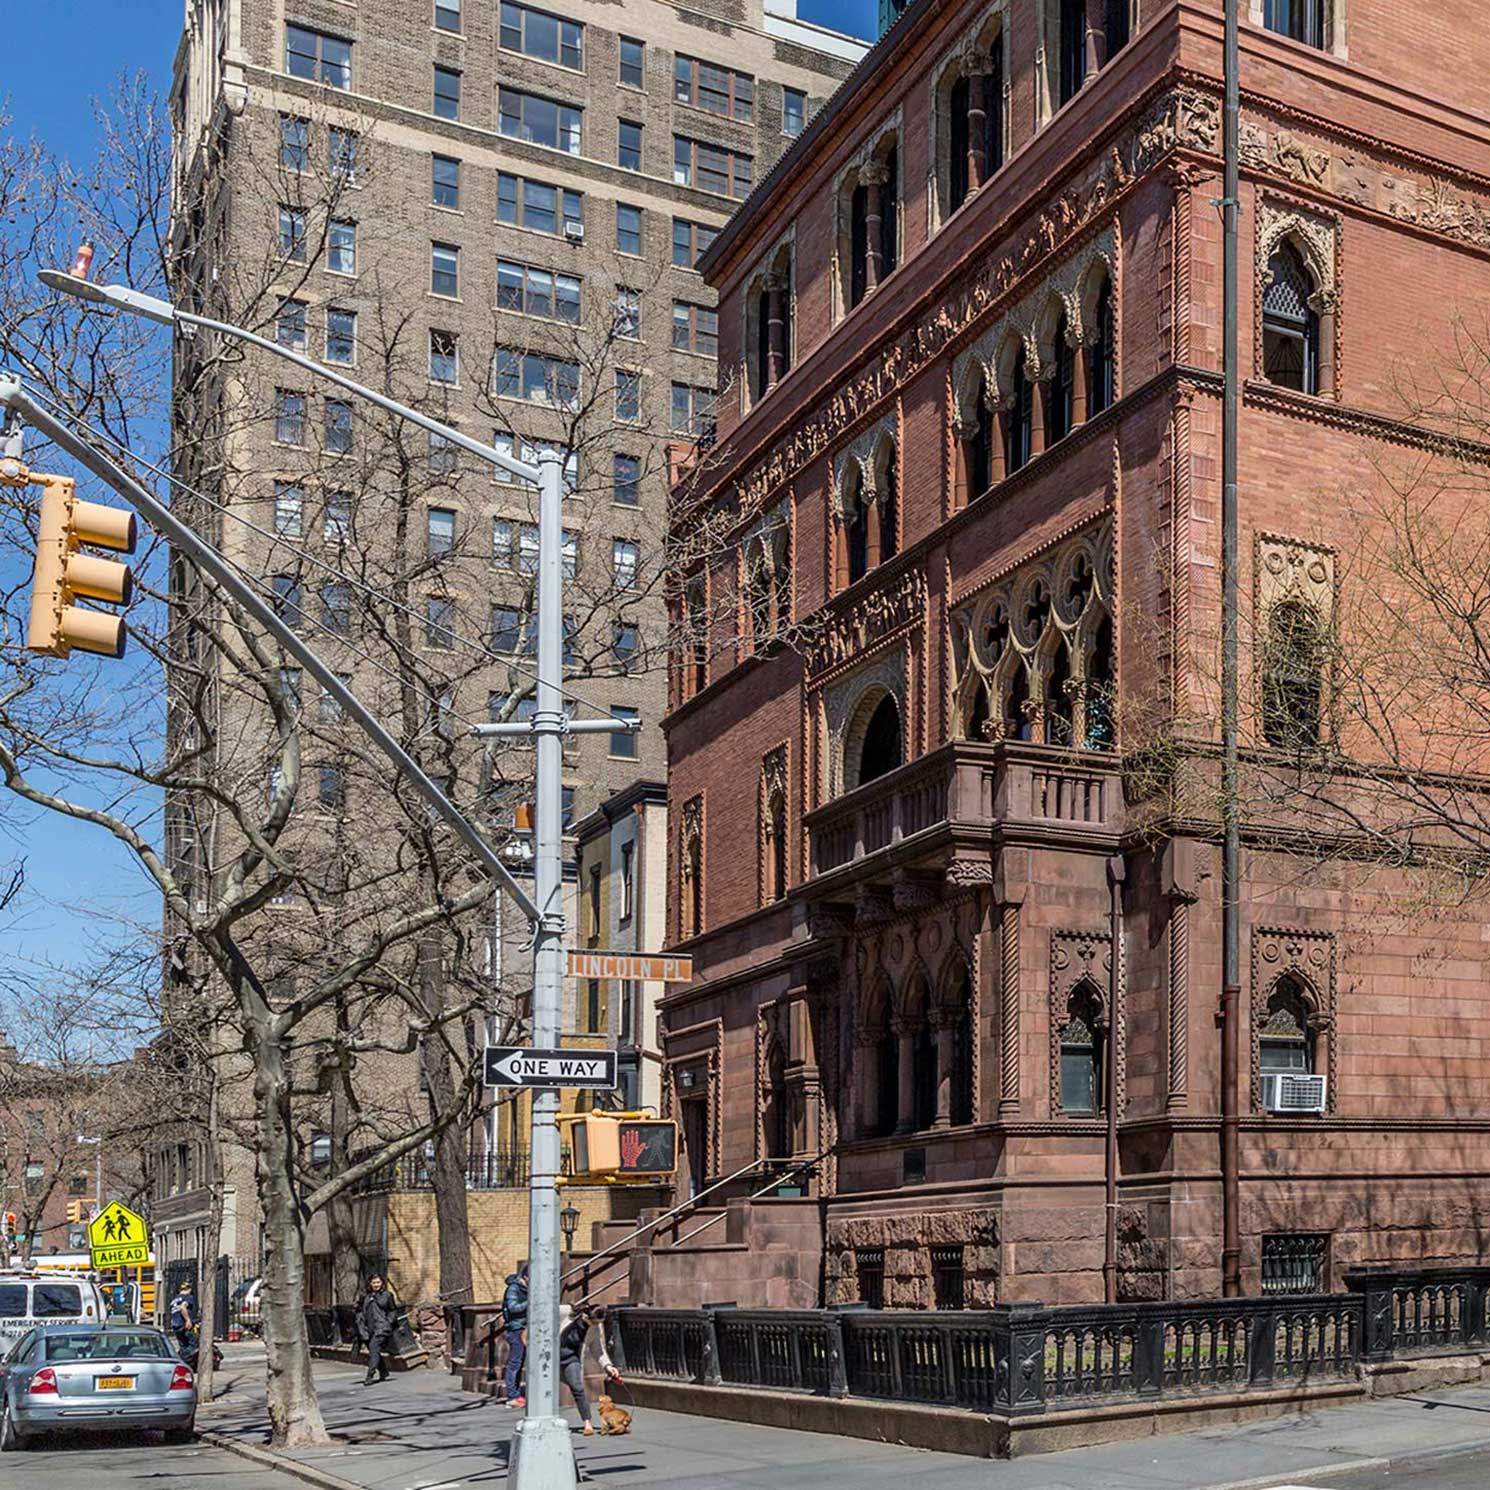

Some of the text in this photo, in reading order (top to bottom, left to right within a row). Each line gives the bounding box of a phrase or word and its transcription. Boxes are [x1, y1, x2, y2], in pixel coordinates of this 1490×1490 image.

[573, 955, 684, 980] LINCOLN PL
[510, 1060, 598, 1076] ONE WAY
[100, 1249, 143, 1263] AHEAD
